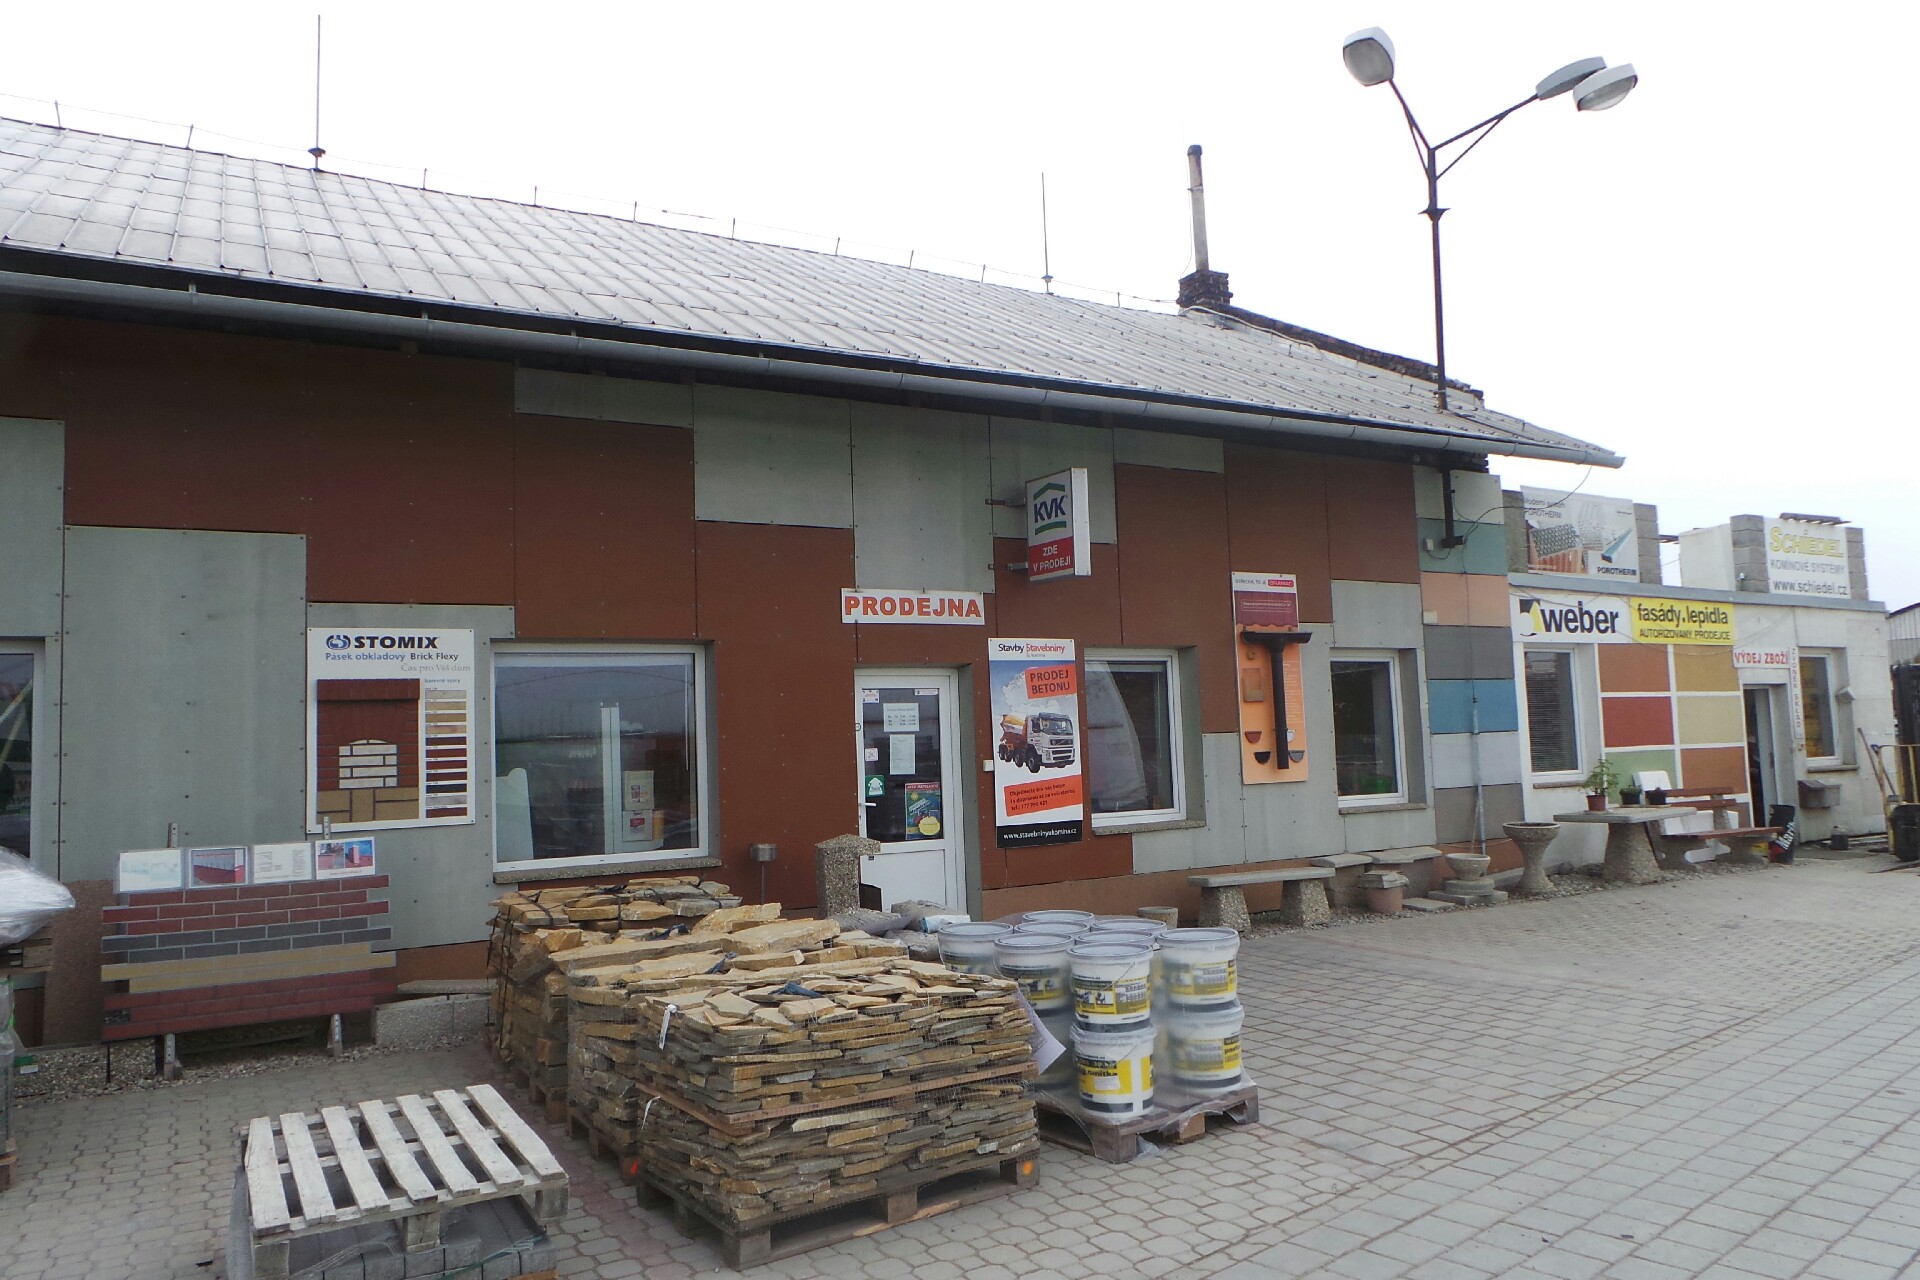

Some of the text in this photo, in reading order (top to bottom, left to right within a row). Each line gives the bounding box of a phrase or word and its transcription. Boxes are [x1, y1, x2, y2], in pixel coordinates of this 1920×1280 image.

[1033, 495, 1066, 523] KVK
[1042, 545, 1058, 556] ZDE
[1033, 555, 1071, 572] V PRODEJI
[1597, 566, 1637, 576] POROTHERM
[1773, 580, 1848, 596] www.schiedel.cz
[844, 595, 982, 618] PRODEJNA
[1540, 601, 1619, 634] weber
[354, 635, 439, 649] STOMIX
[1694, 630, 1731, 640] PRODEJCE
[998, 643, 1066, 654] Stavby Stavebniny
[410, 652, 434, 660] Brick
[436, 652, 459, 662] Flexy
[1734, 650, 1789, 665] VÝDEJ ZBOŽÍ
[401, 663, 418, 672] Čas
[419, 665, 434, 674] pro
[1030, 669, 1069, 683] PRODEJ
[1031, 682, 1070, 695] BETONU
